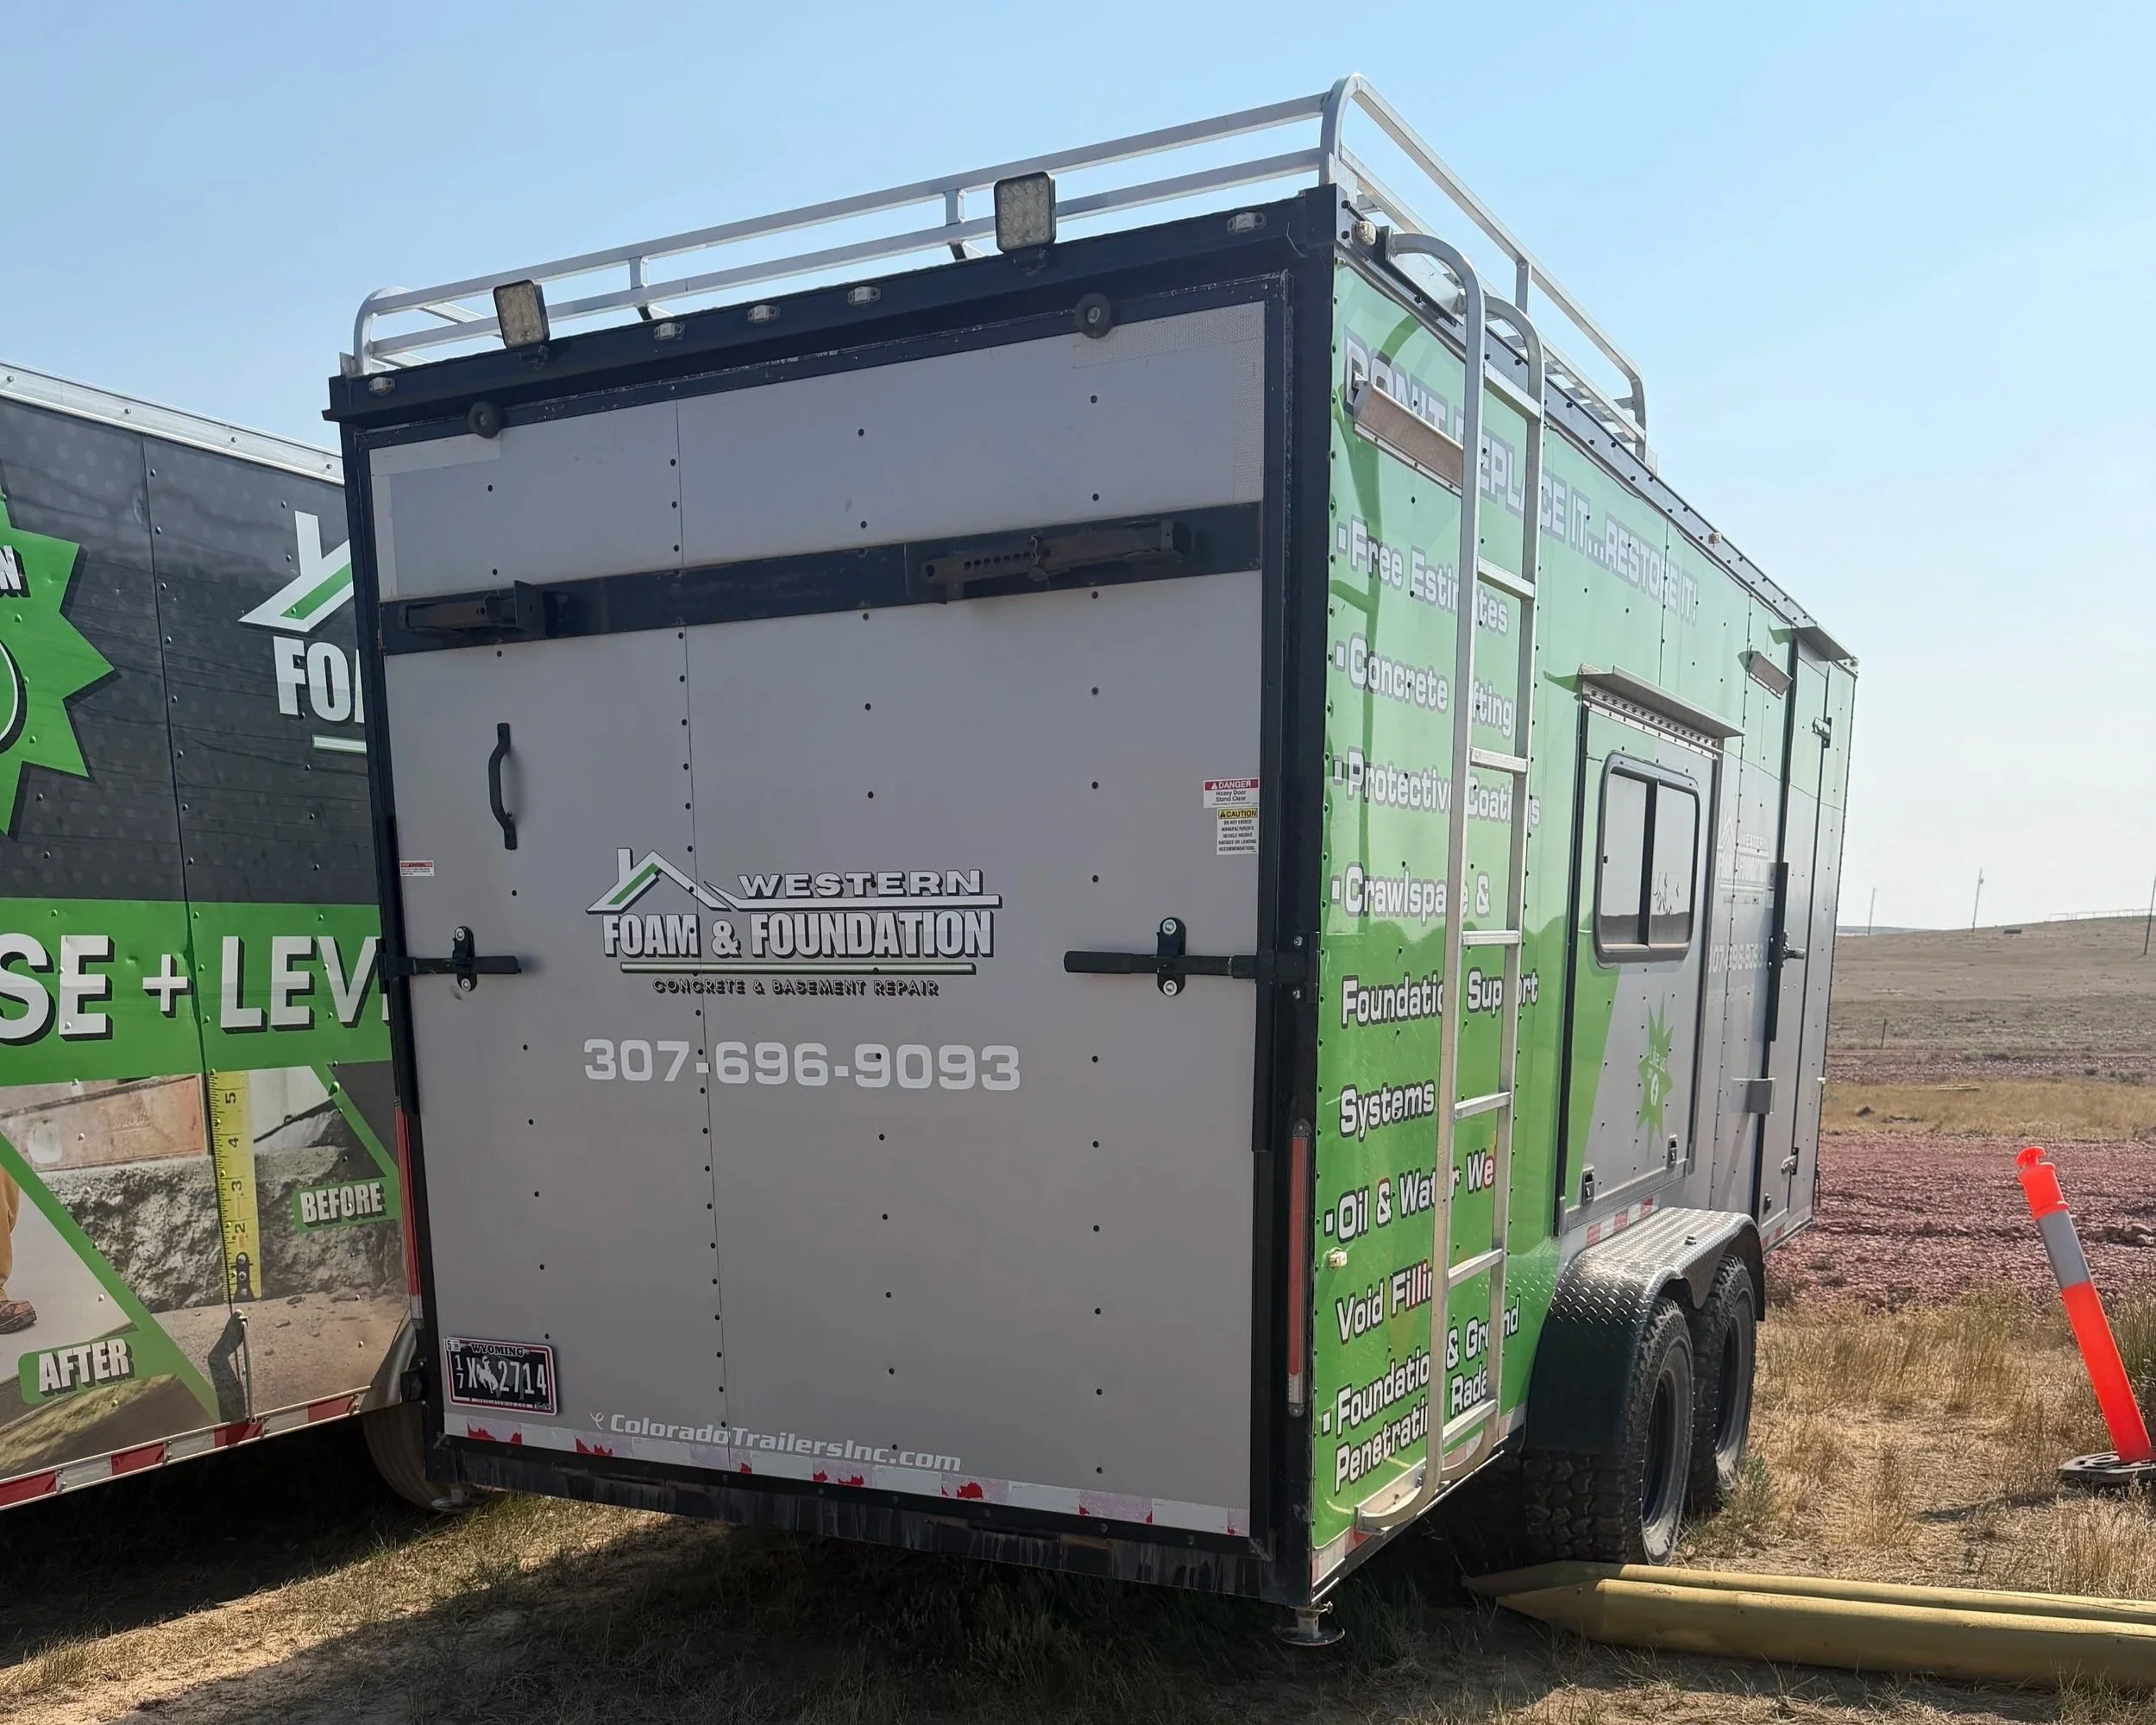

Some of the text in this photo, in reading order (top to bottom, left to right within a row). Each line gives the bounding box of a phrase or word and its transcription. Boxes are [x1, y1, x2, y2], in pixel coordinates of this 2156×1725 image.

[1456, 414, 1566, 538] EPLCE
[1350, 519, 1509, 633] Free Estites
[273, 635, 366, 724] FO
[1349, 636, 1513, 737] Concrete fting
[1218, 780, 1252, 789] DANGER
[1347, 750, 1541, 825] Protectiv Coatis
[1226, 809, 1257, 818] CAUTION
[739, 869, 983, 900] WESTERN
[1344, 866, 1490, 923] Crawlspa &
[603, 910, 994, 957] FOAM & FOUNDATION
[220, 935, 390, 1031] LEV
[653, 979, 939, 996] CONCRETE & BASEMENT REPAIR
[1342, 970, 1539, 1026] Foundati Suprt
[584, 1039, 1021, 1091] 307-696-9093
[1340, 1081, 1436, 1139] Systems
[299, 1183, 385, 1225] BEFORE
[1339, 1151, 1494, 1240] Oil & Watr We
[1336, 1262, 1432, 1343] Void Filli
[38, 1339, 129, 1394] AFTER
[471, 1343, 524, 1357] WYOMING
[498, 1360, 547, 1396] 2714
[1336, 1296, 1521, 1436] Foundatio & Grnd
[610, 1413, 962, 1471] ColoradoTrailersInc.com
[1335, 1363, 1487, 1495] Penetrati Rad
